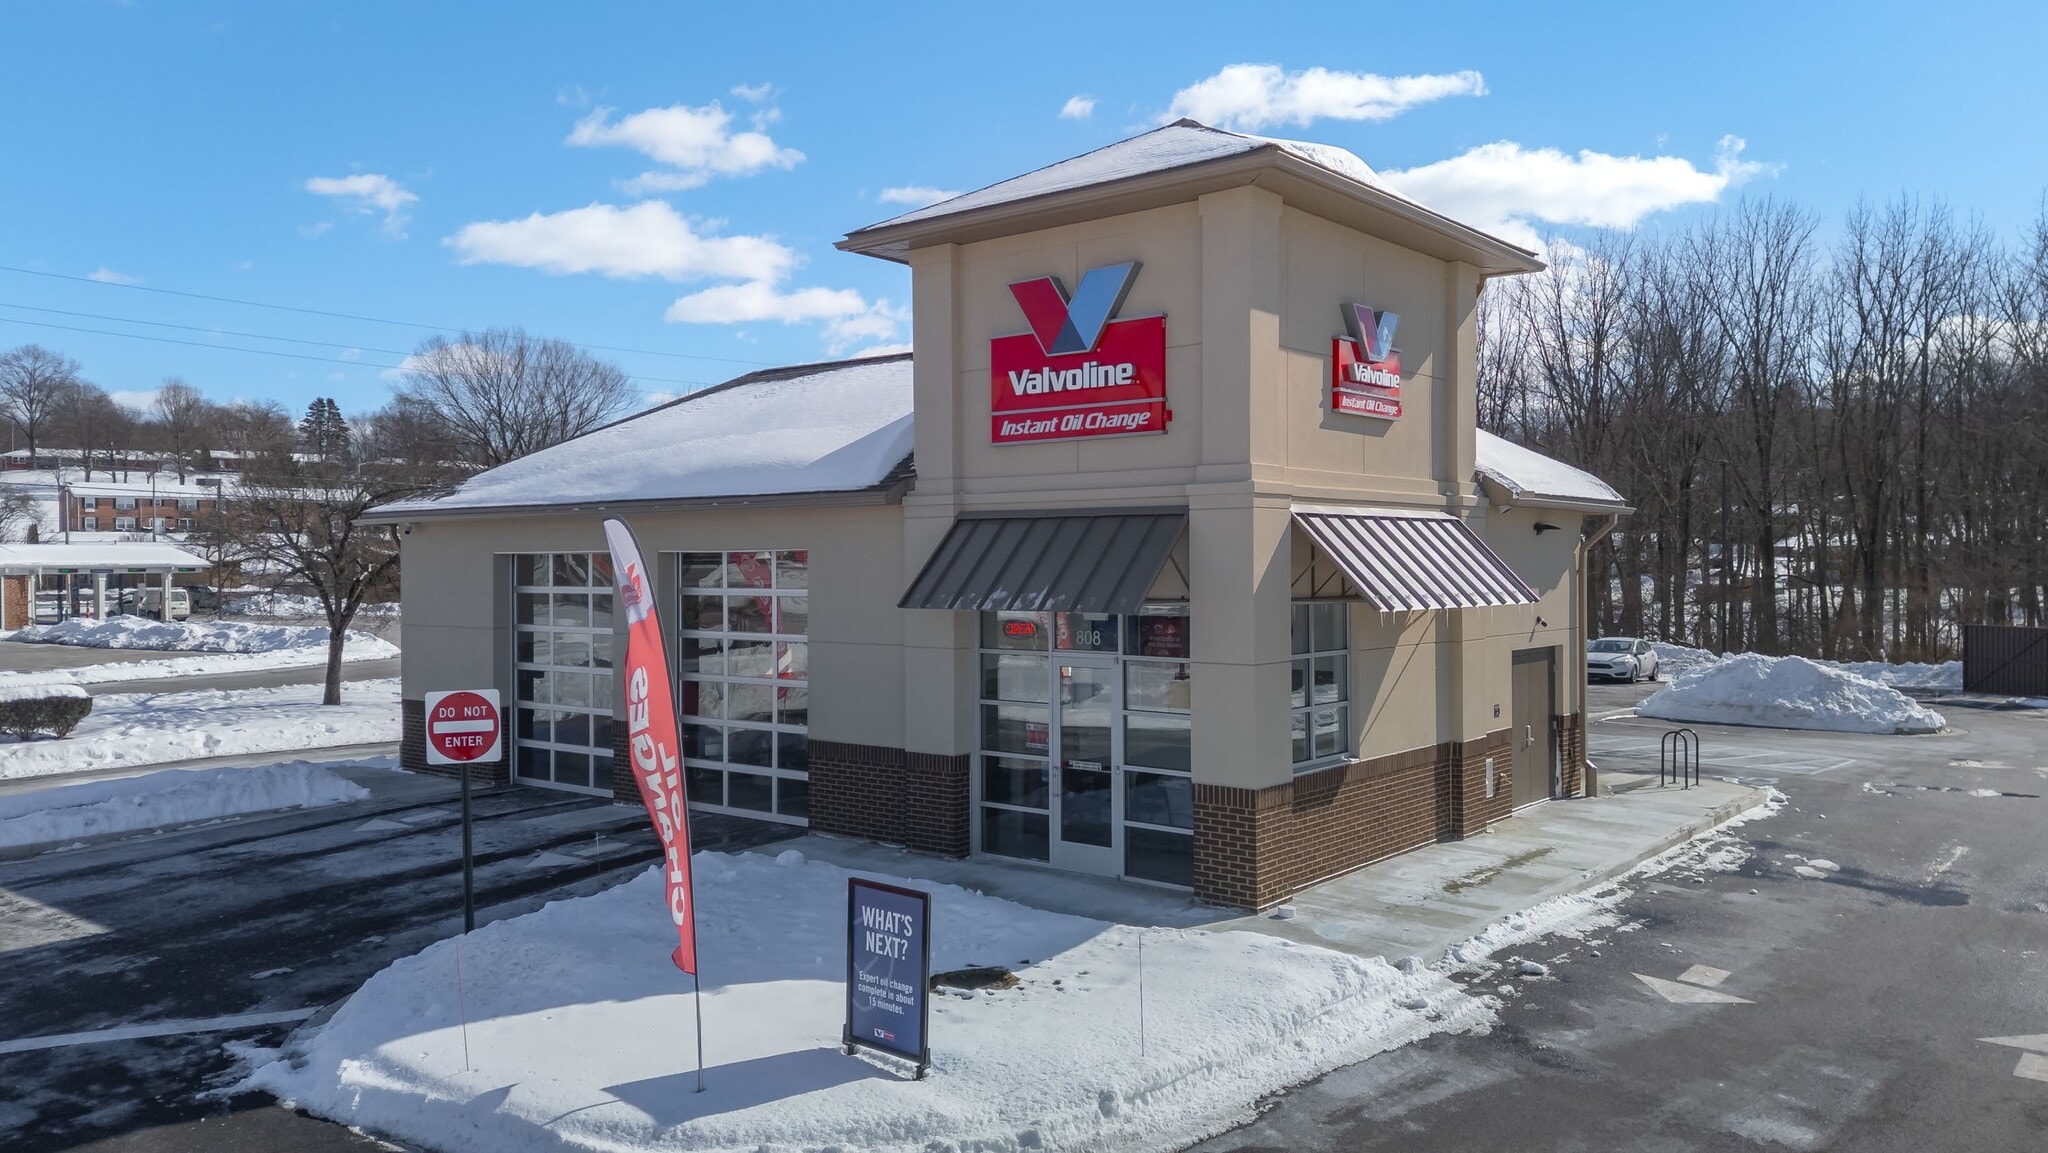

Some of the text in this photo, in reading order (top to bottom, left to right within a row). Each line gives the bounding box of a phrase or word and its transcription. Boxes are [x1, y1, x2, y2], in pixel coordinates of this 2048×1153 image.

[1008, 360, 1133, 396] Valvoline
[1353, 363, 1400, 388] Valvoline
[1341, 395, 1399, 416] Instant Oil Change
[1000, 411, 1152, 436] Instant Oil Change
[1005, 622, 1034, 634] OPEN
[1076, 630, 1101, 646] 808
[439, 705, 487, 718] DO NOT
[445, 735, 483, 748] ENTER
[861, 905, 913, 937] WHAT'S
[866, 930, 908, 961] NEXT?
[859, 970, 913, 995] Expert oil change
[857, 983, 914, 1006] complete in about
[869, 996, 905, 1015] 15 minutes.
